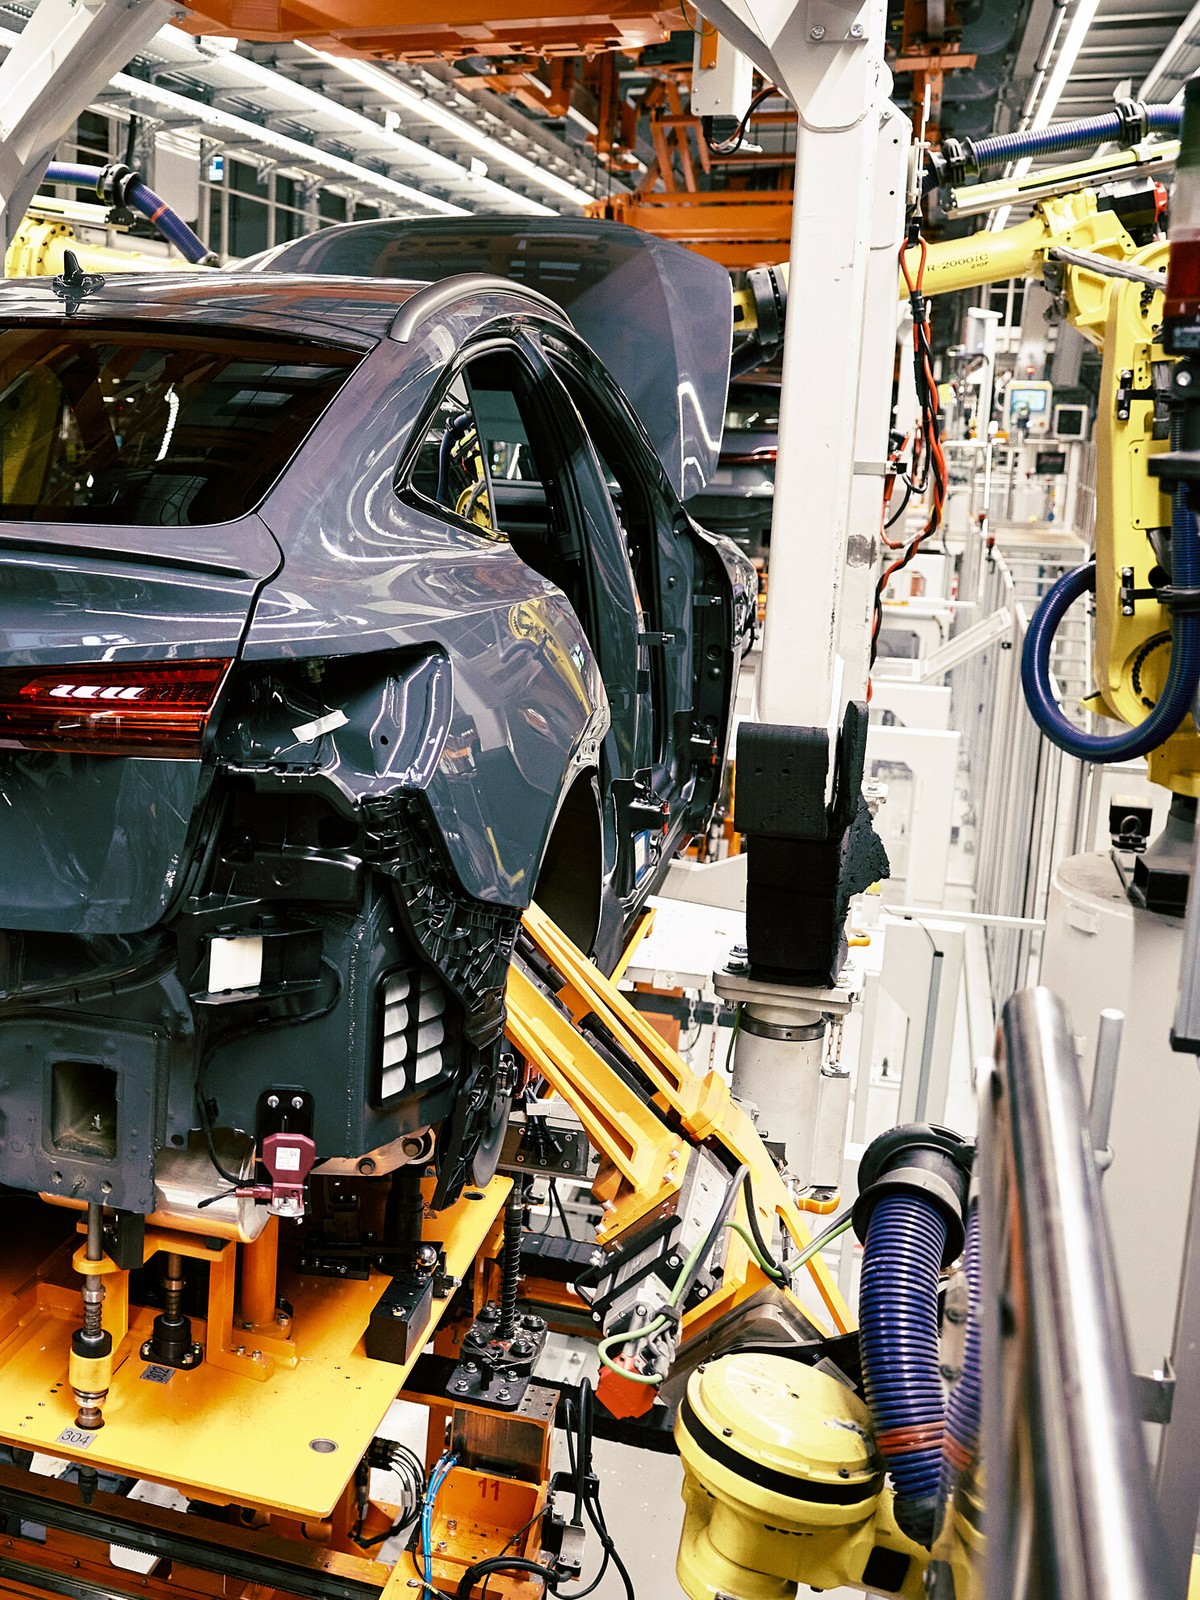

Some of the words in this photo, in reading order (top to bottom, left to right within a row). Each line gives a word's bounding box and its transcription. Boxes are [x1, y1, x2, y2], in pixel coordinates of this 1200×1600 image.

[146, 1366, 170, 1382] 302
[61, 1430, 91, 1446] 304
[477, 1477, 501, 1502] 11
